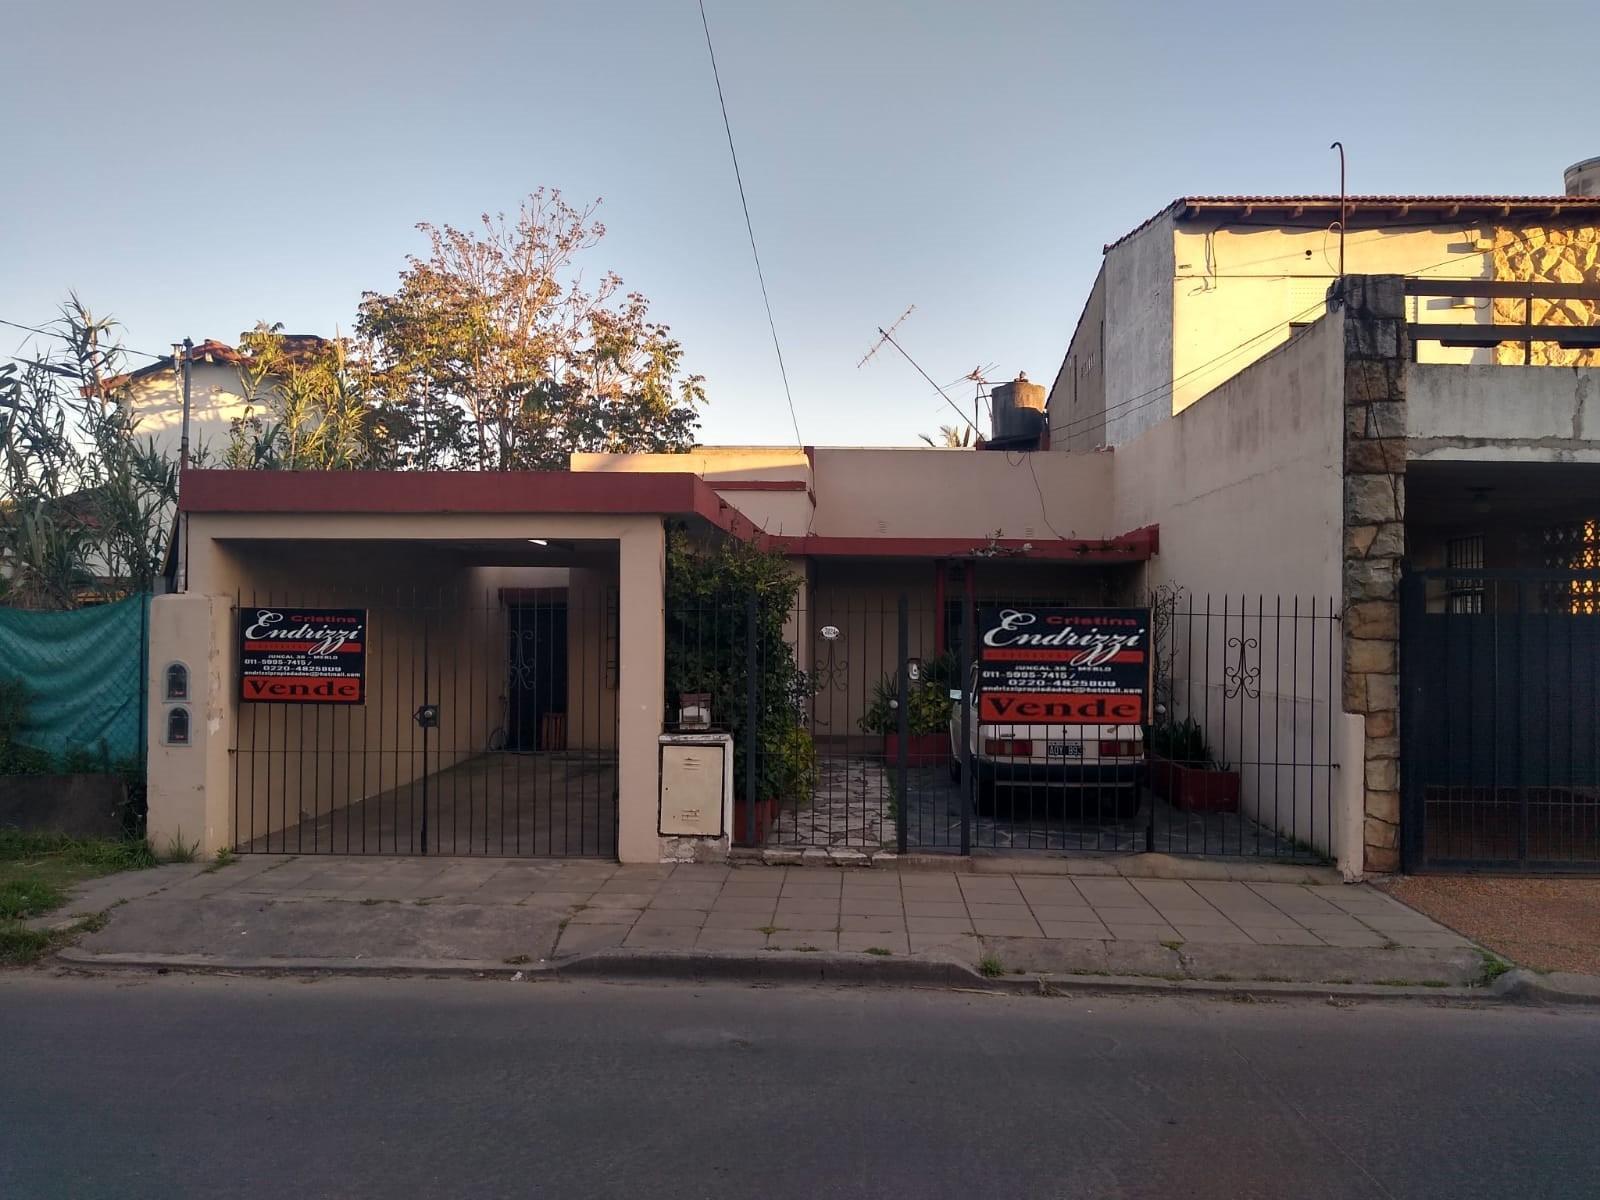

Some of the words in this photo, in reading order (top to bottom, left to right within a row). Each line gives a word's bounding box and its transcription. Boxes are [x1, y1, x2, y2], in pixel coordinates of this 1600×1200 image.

[290, 615, 357, 623] Cristina
[1046, 616, 1137, 626] Cristina
[245, 609, 363, 656] Endrizzi
[983, 609, 1145, 667] Endrizzi
[248, 679, 356, 697] Vende
[988, 697, 1137, 718] Vende
